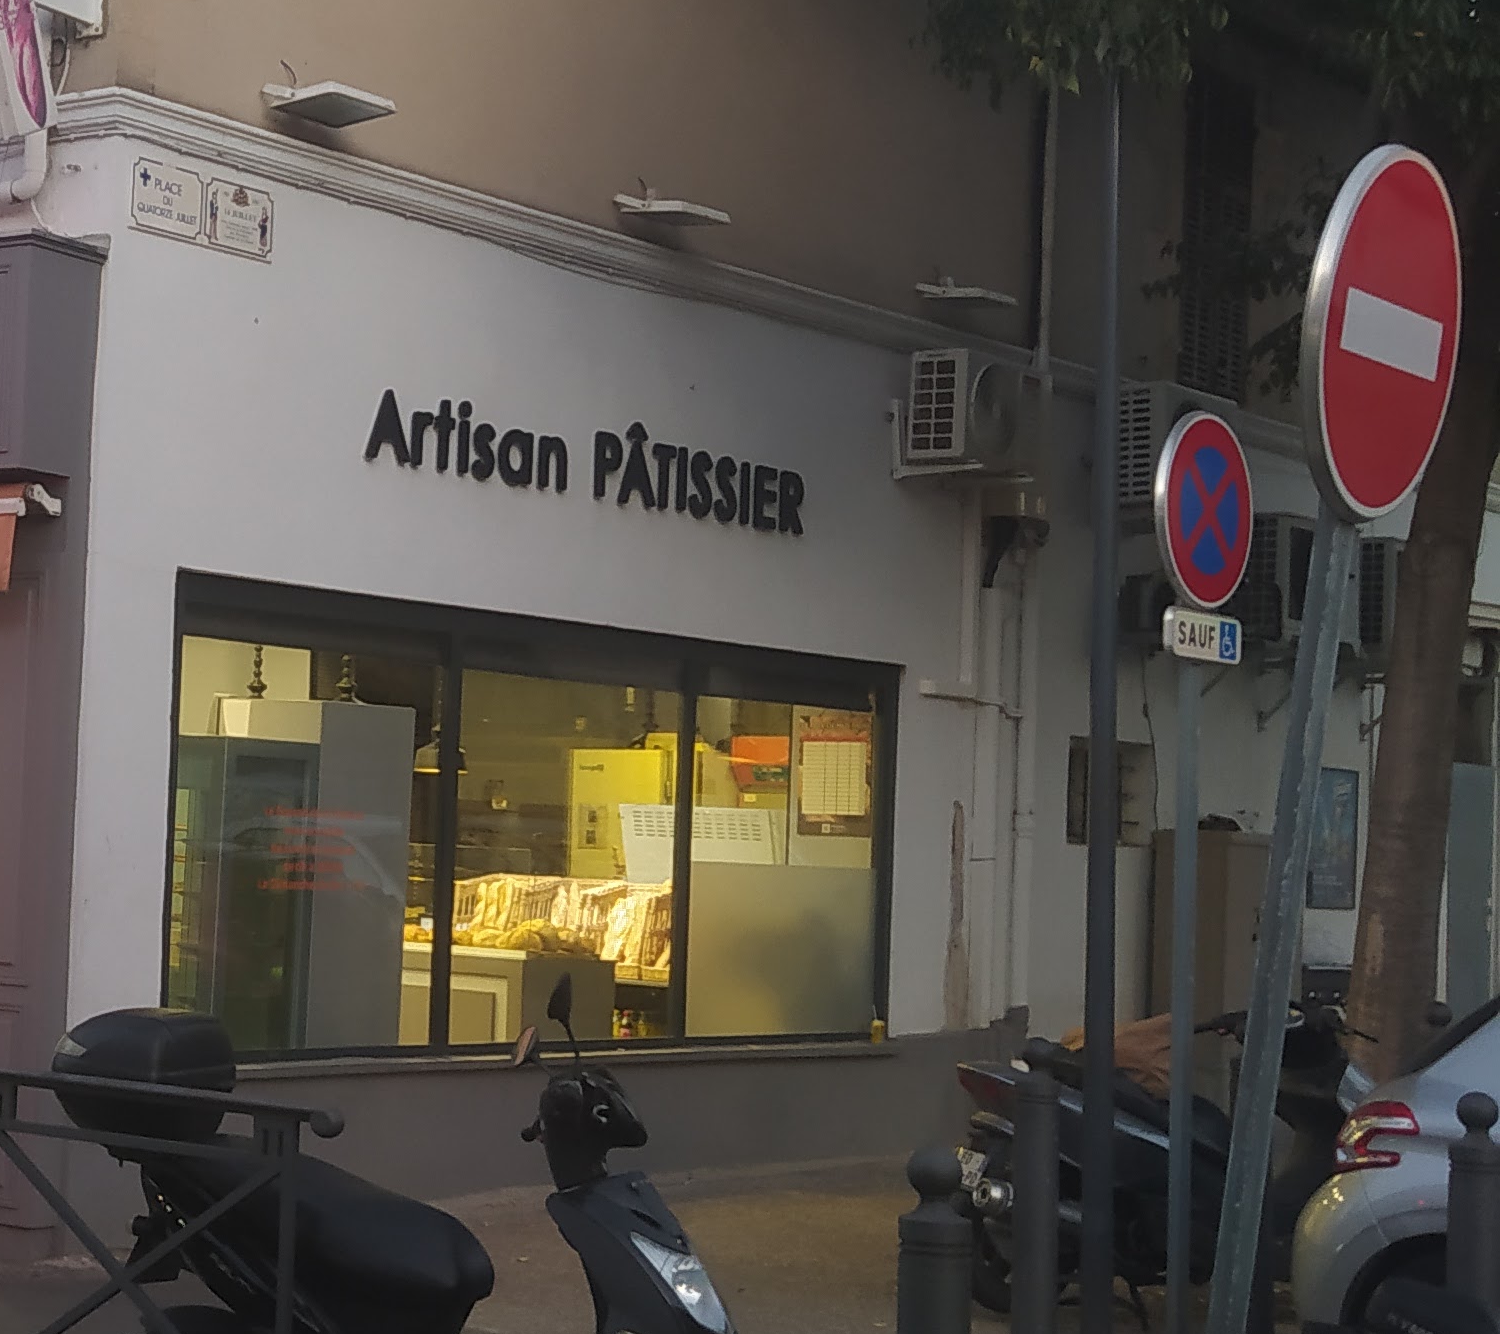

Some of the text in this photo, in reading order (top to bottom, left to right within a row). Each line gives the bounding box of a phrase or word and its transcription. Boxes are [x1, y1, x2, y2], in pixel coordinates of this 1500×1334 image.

[154, 177, 183, 197] PLACE
[137, 201, 174, 220] QUATORZE
[162, 195, 173, 207] DU
[363, 387, 806, 536] Artisan PÂTISSIER
[1178, 620, 1216, 649] SAUF
